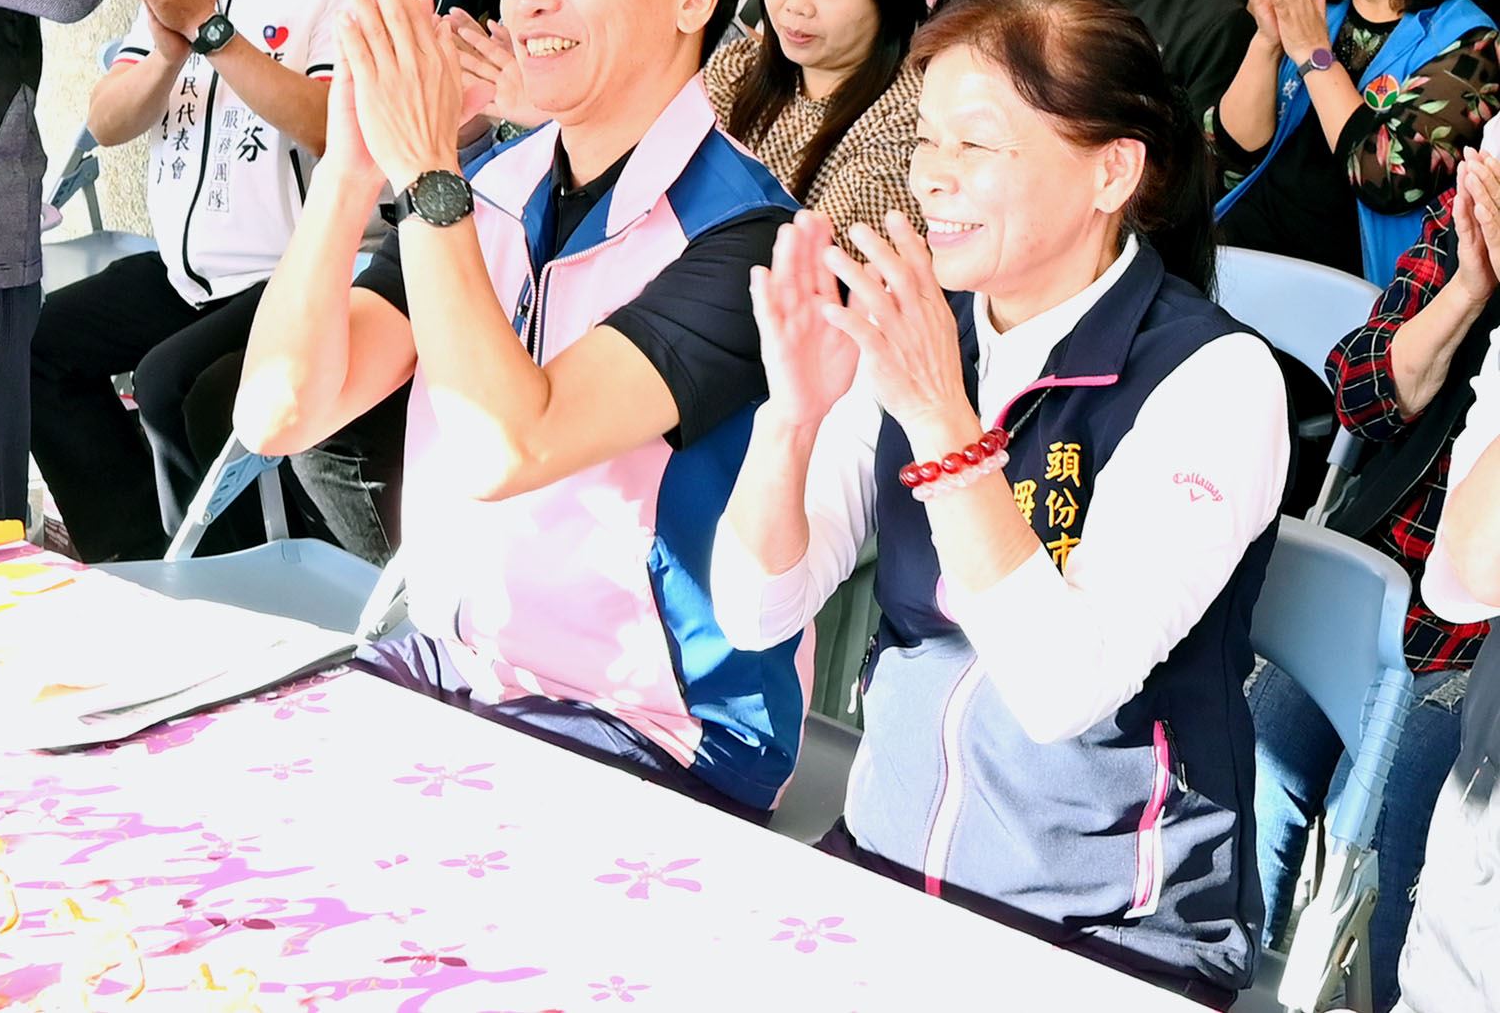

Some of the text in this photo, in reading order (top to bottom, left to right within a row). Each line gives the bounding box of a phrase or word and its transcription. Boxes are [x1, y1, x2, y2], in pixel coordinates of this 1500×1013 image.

[1044, 441, 1082, 570] 頭份市
[1172, 472, 1224, 503] Callaway
